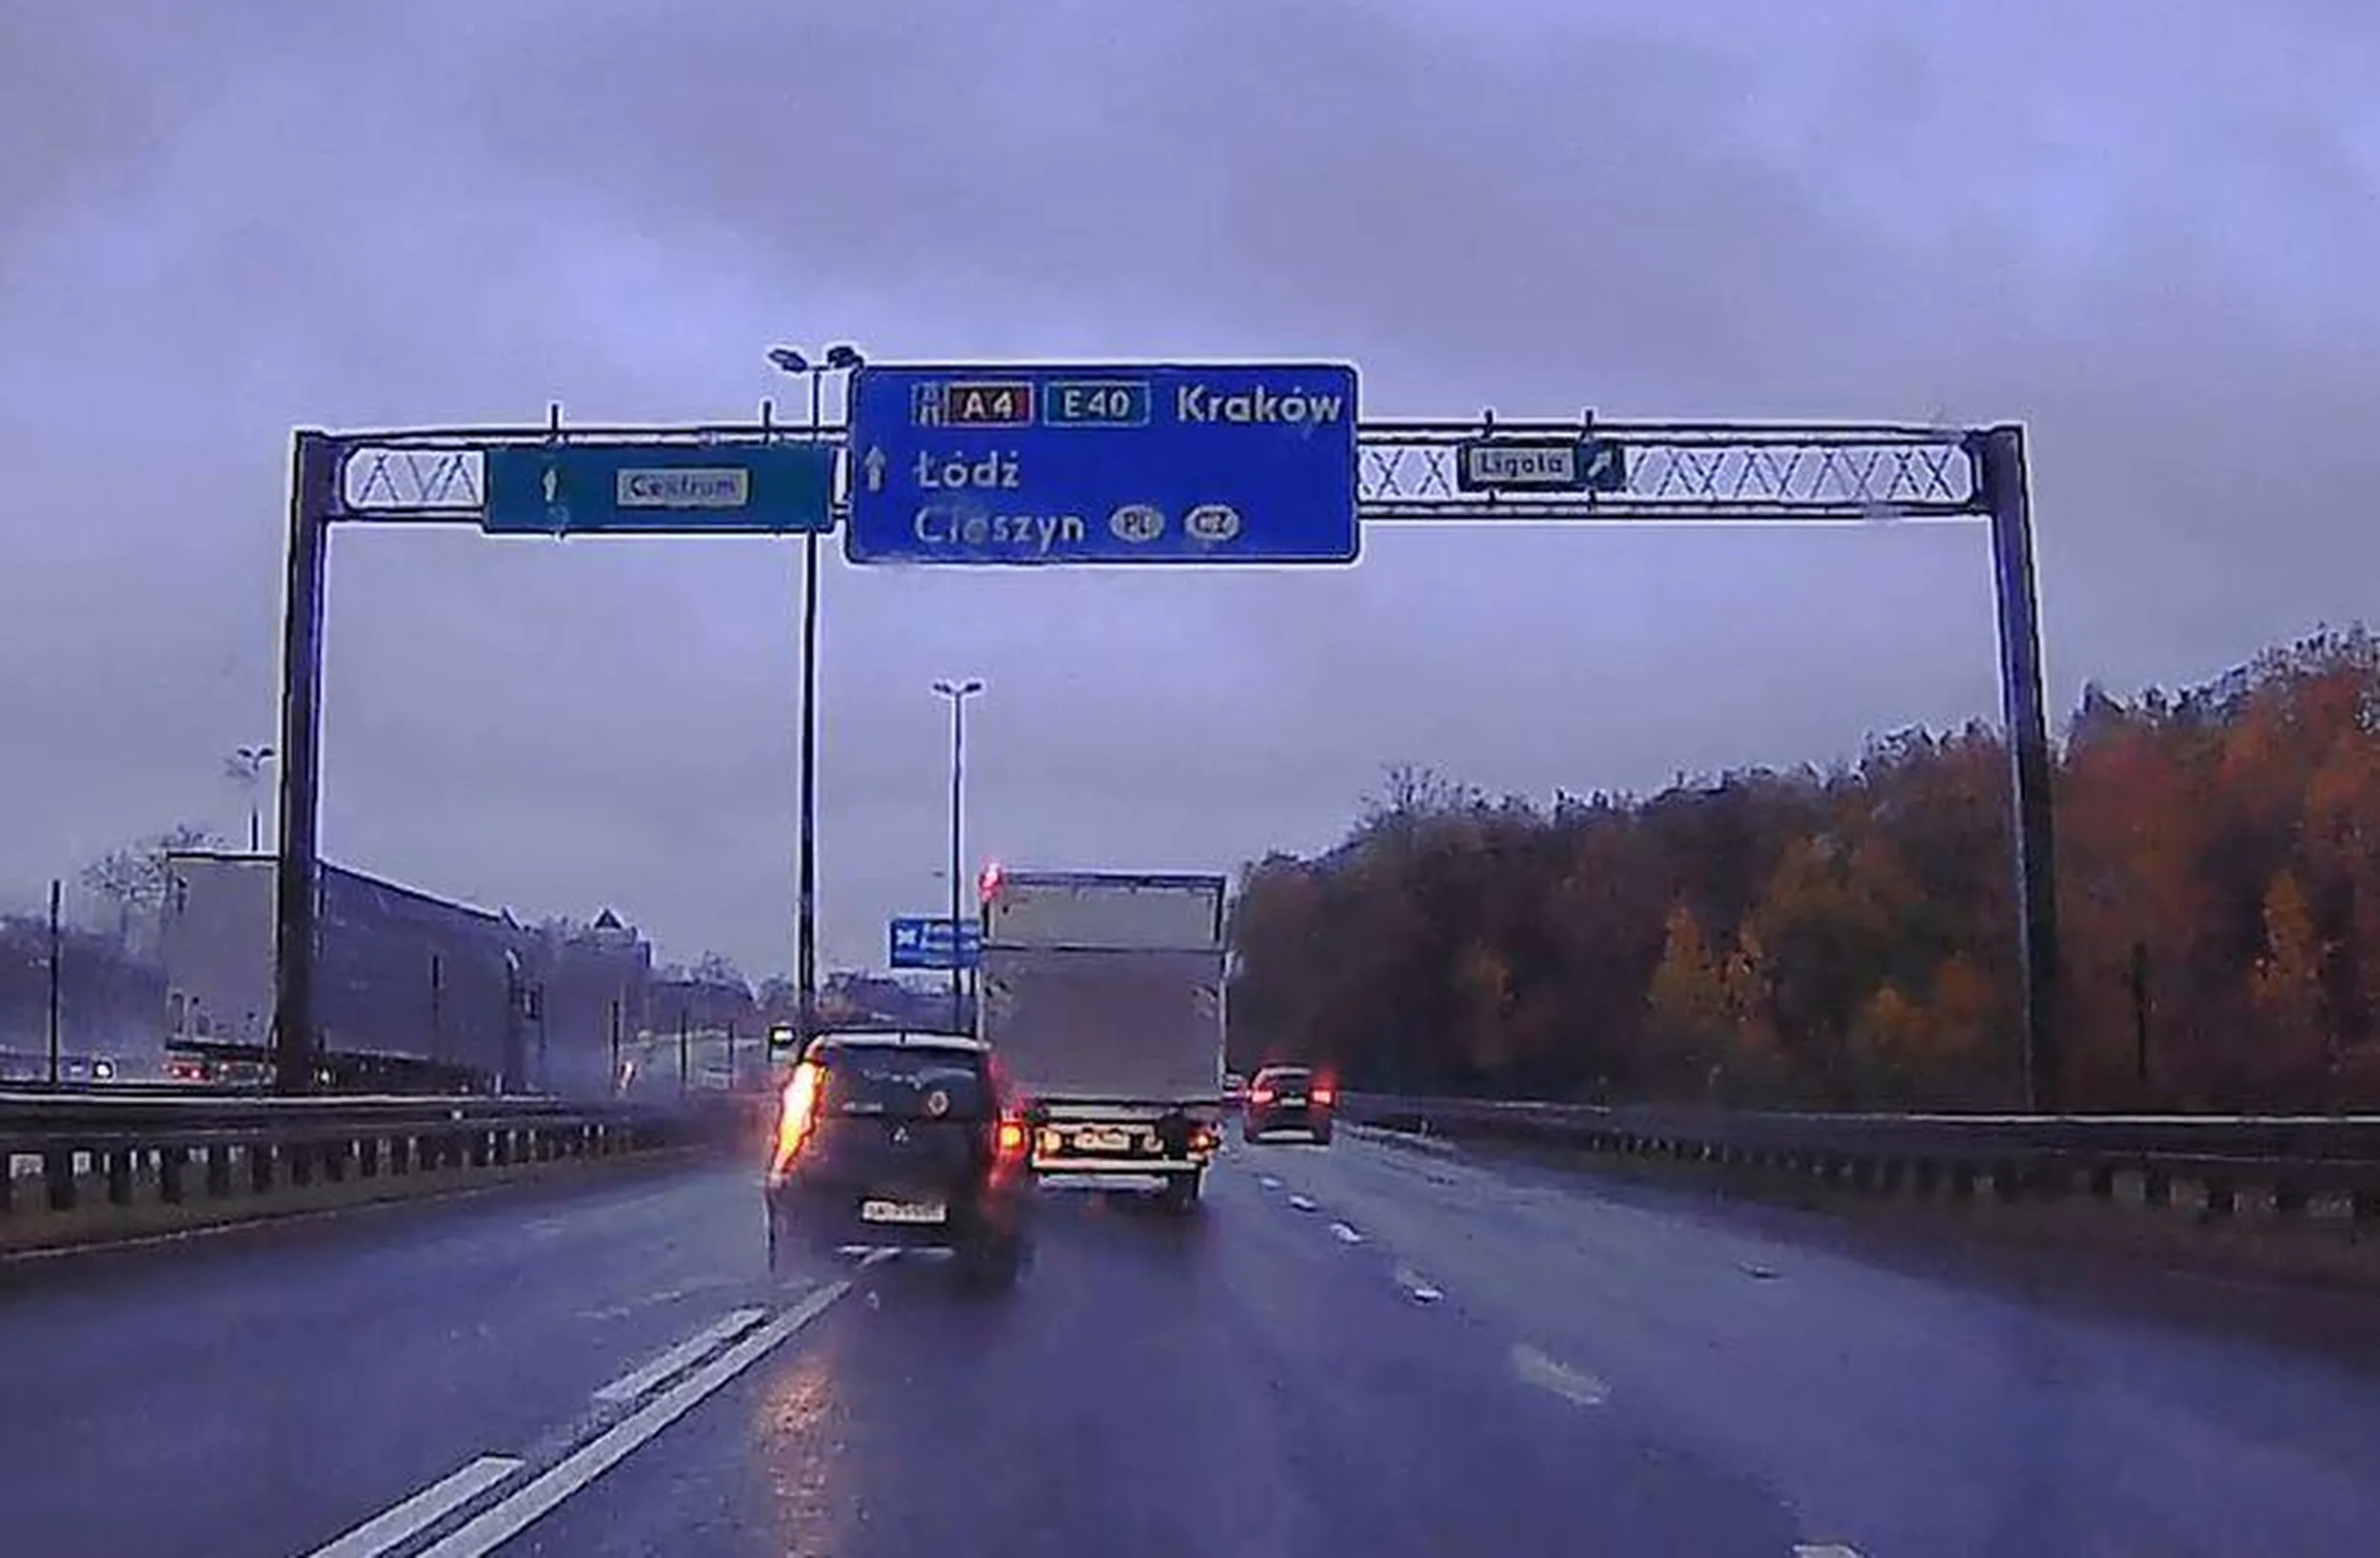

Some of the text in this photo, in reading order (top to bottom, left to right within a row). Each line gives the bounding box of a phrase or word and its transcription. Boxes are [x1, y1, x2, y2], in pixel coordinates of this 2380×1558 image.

[1063, 390, 1130, 417] E40
[1178, 385, 1342, 423] Kraków
[914, 506, 1084, 553] Cieszyn
